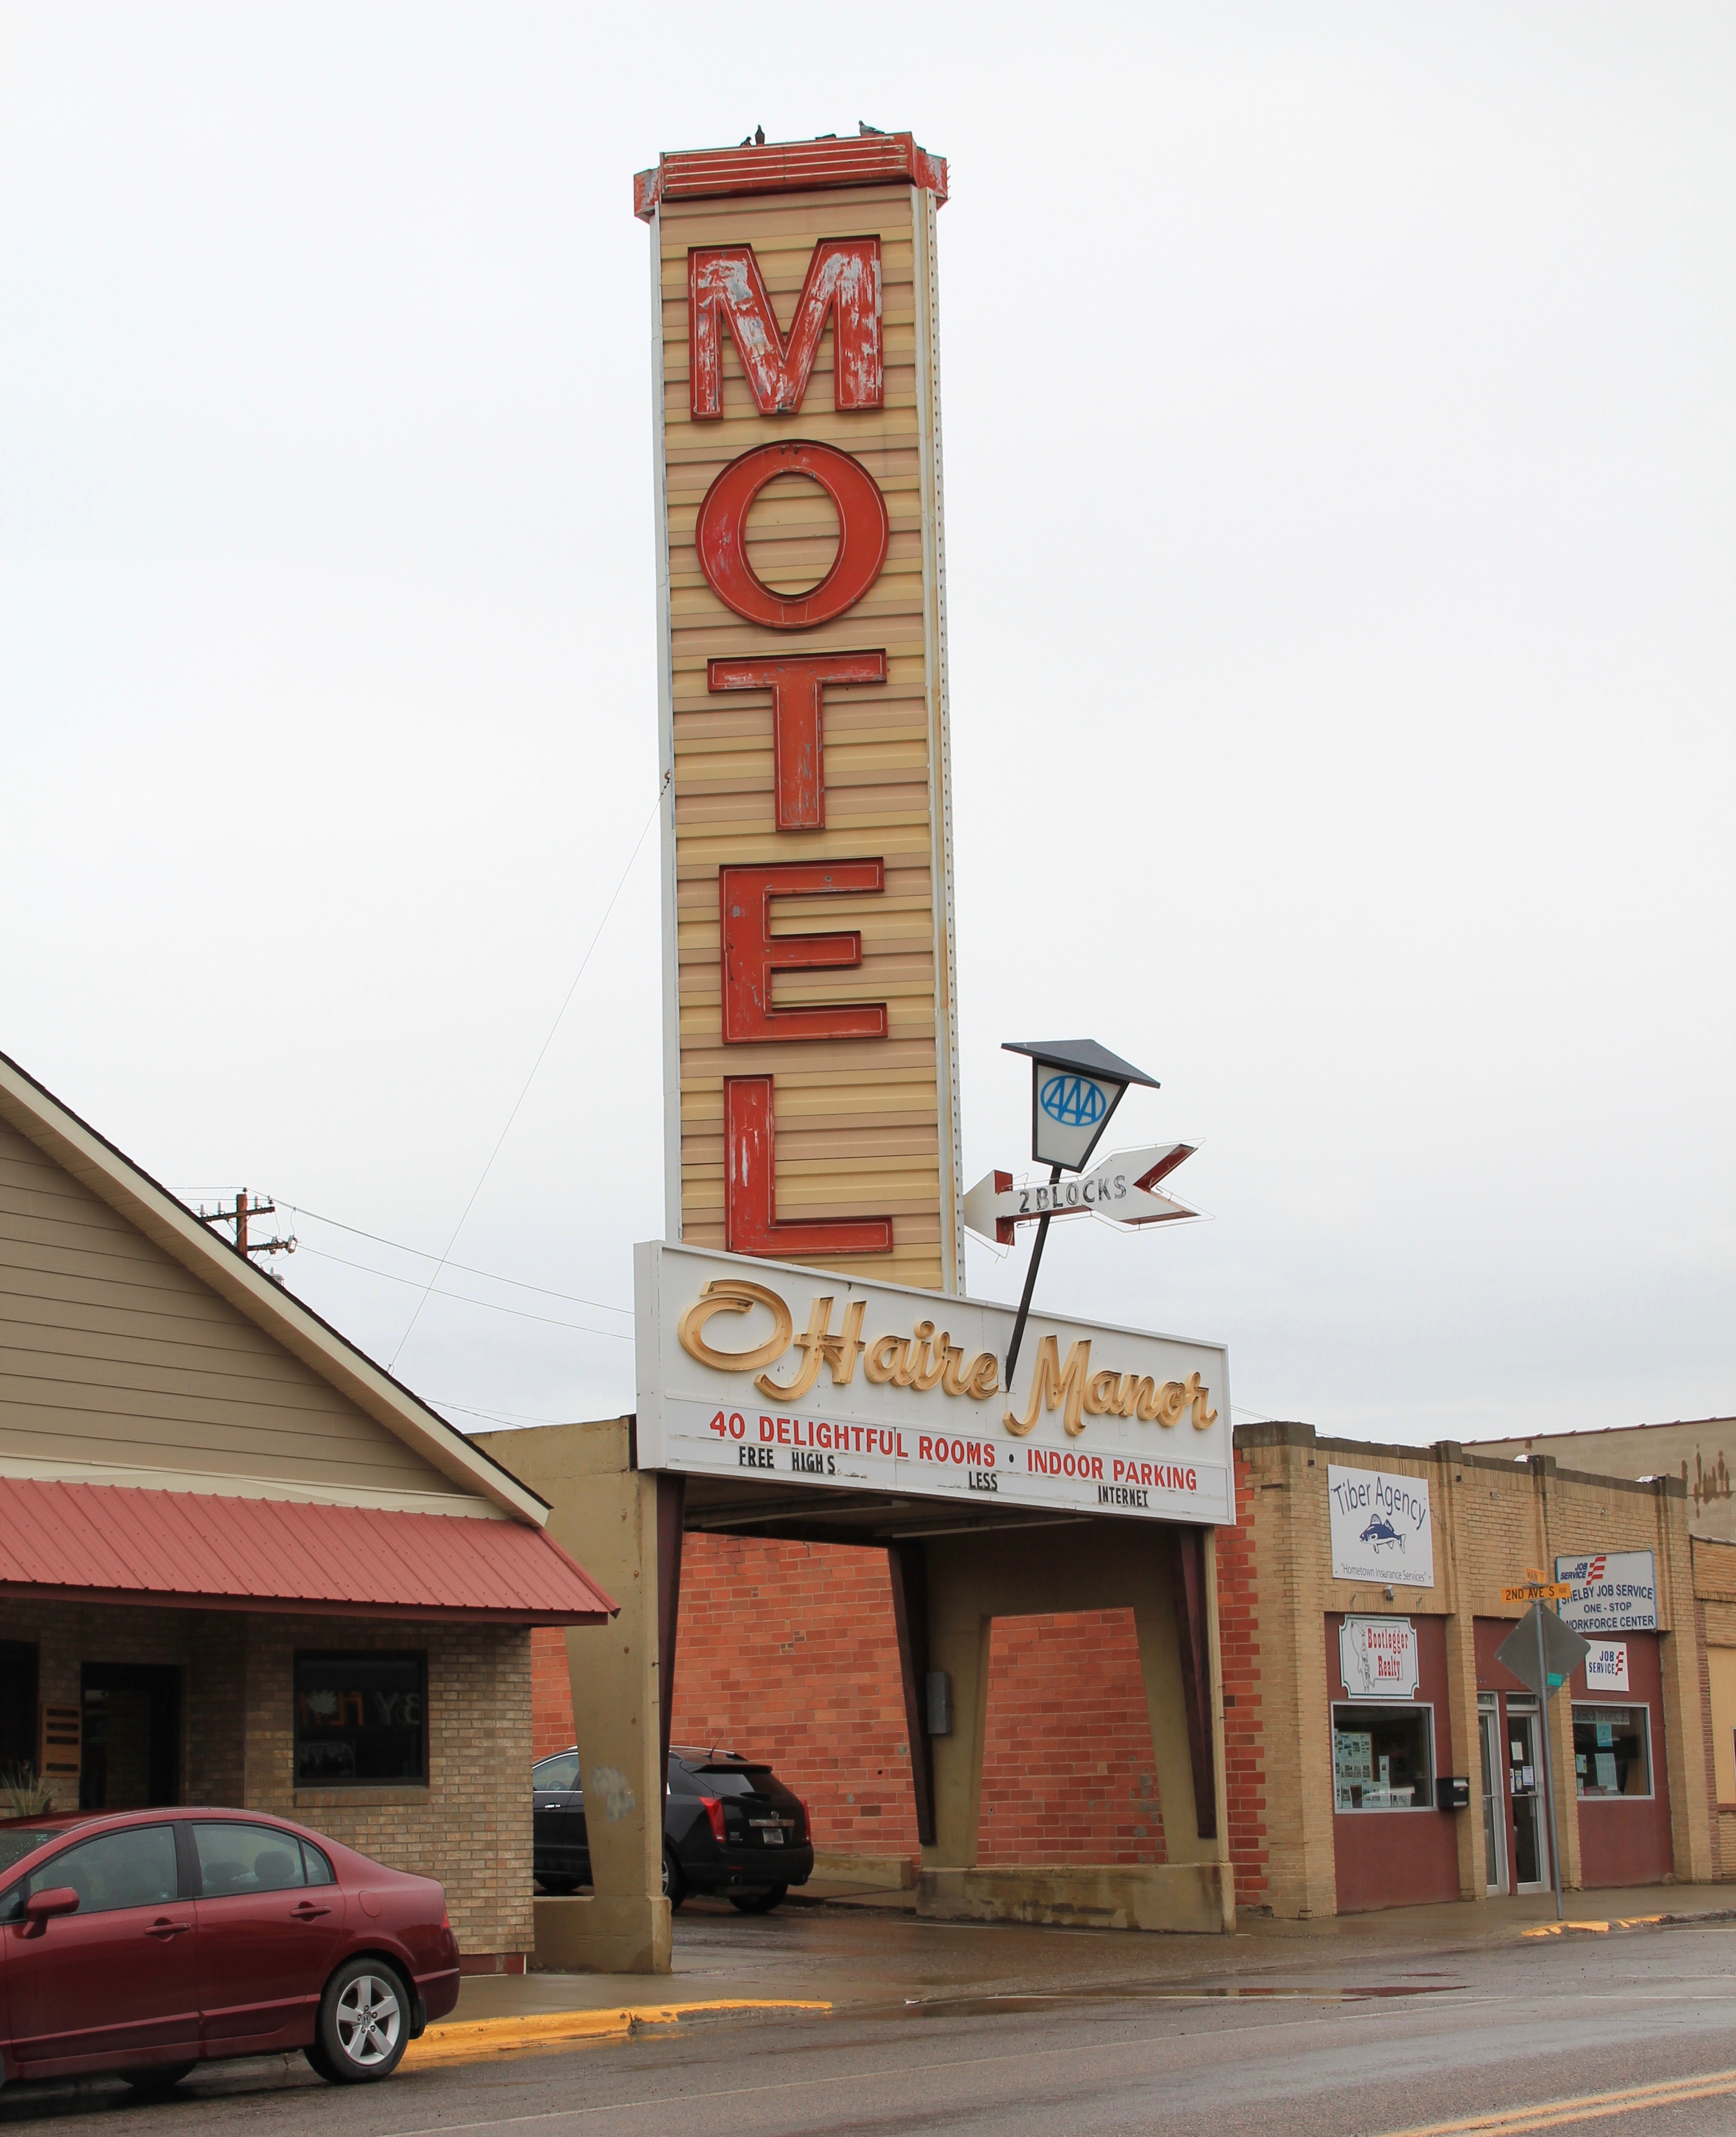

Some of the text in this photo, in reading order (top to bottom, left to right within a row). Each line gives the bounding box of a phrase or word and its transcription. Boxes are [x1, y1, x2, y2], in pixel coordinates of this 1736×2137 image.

[688, 233, 893, 1254] MOTEL
[1043, 1076, 1101, 1126] AAA
[1003, 1334, 1218, 1436] Manor
[710, 1411, 1197, 1491] 40 DELIGHTFUL ROOMS INDOOR PARKING
[739, 1445, 774, 1468] FREE
[969, 1471, 998, 1492] LESS
[1098, 1485, 1149, 1507] INTERNET
[1331, 1476, 1426, 1531] Tiber Agency
[1375, 1567, 1402, 1581] Insurance
[1560, 1571, 1587, 1580] SERVICE
[1505, 1589, 1524, 1601] 2ND
[1528, 1587, 1544, 1599] AVE
[1549, 1586, 1555, 1597] S
[1597, 1585, 1613, 1597] JOB
[1616, 1584, 1653, 1600] SERVICE
[1584, 1604, 1601, 1613] ONE
[1609, 1602, 1632, 1611] STOP
[1620, 1615, 1654, 1627] CENTER
[1367, 1628, 1408, 1654] Bootlegger
[1599, 1650, 1614, 1662] JOB
[1378, 1655, 1400, 1681] Realty
[1589, 1662, 1615, 1674] SERVICE
